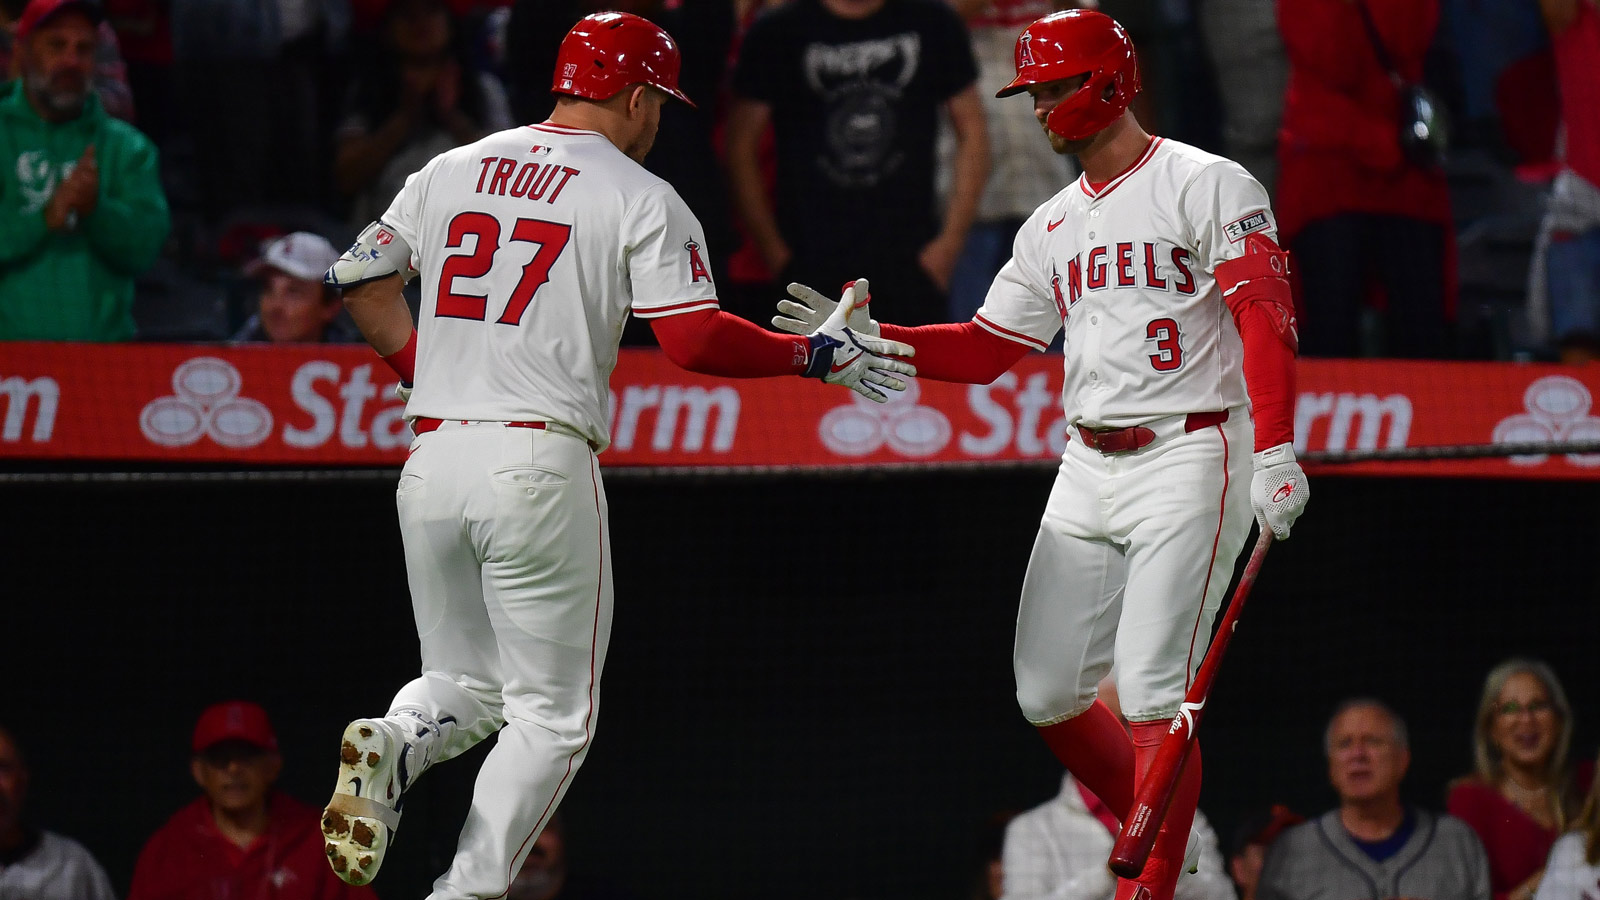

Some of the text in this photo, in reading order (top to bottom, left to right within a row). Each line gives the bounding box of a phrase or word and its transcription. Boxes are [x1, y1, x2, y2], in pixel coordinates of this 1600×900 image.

[562, 63, 578, 78] 27
[475, 156, 581, 205] TROUT
[1242, 214, 1264, 230] FBM
[434, 211, 572, 326] 27
[685, 238, 713, 284] A
[1050, 240, 1198, 326] ANGELS
[1145, 317, 1185, 373] 3
[608, 384, 741, 453] rm
[1168, 695, 1207, 741] Victus
